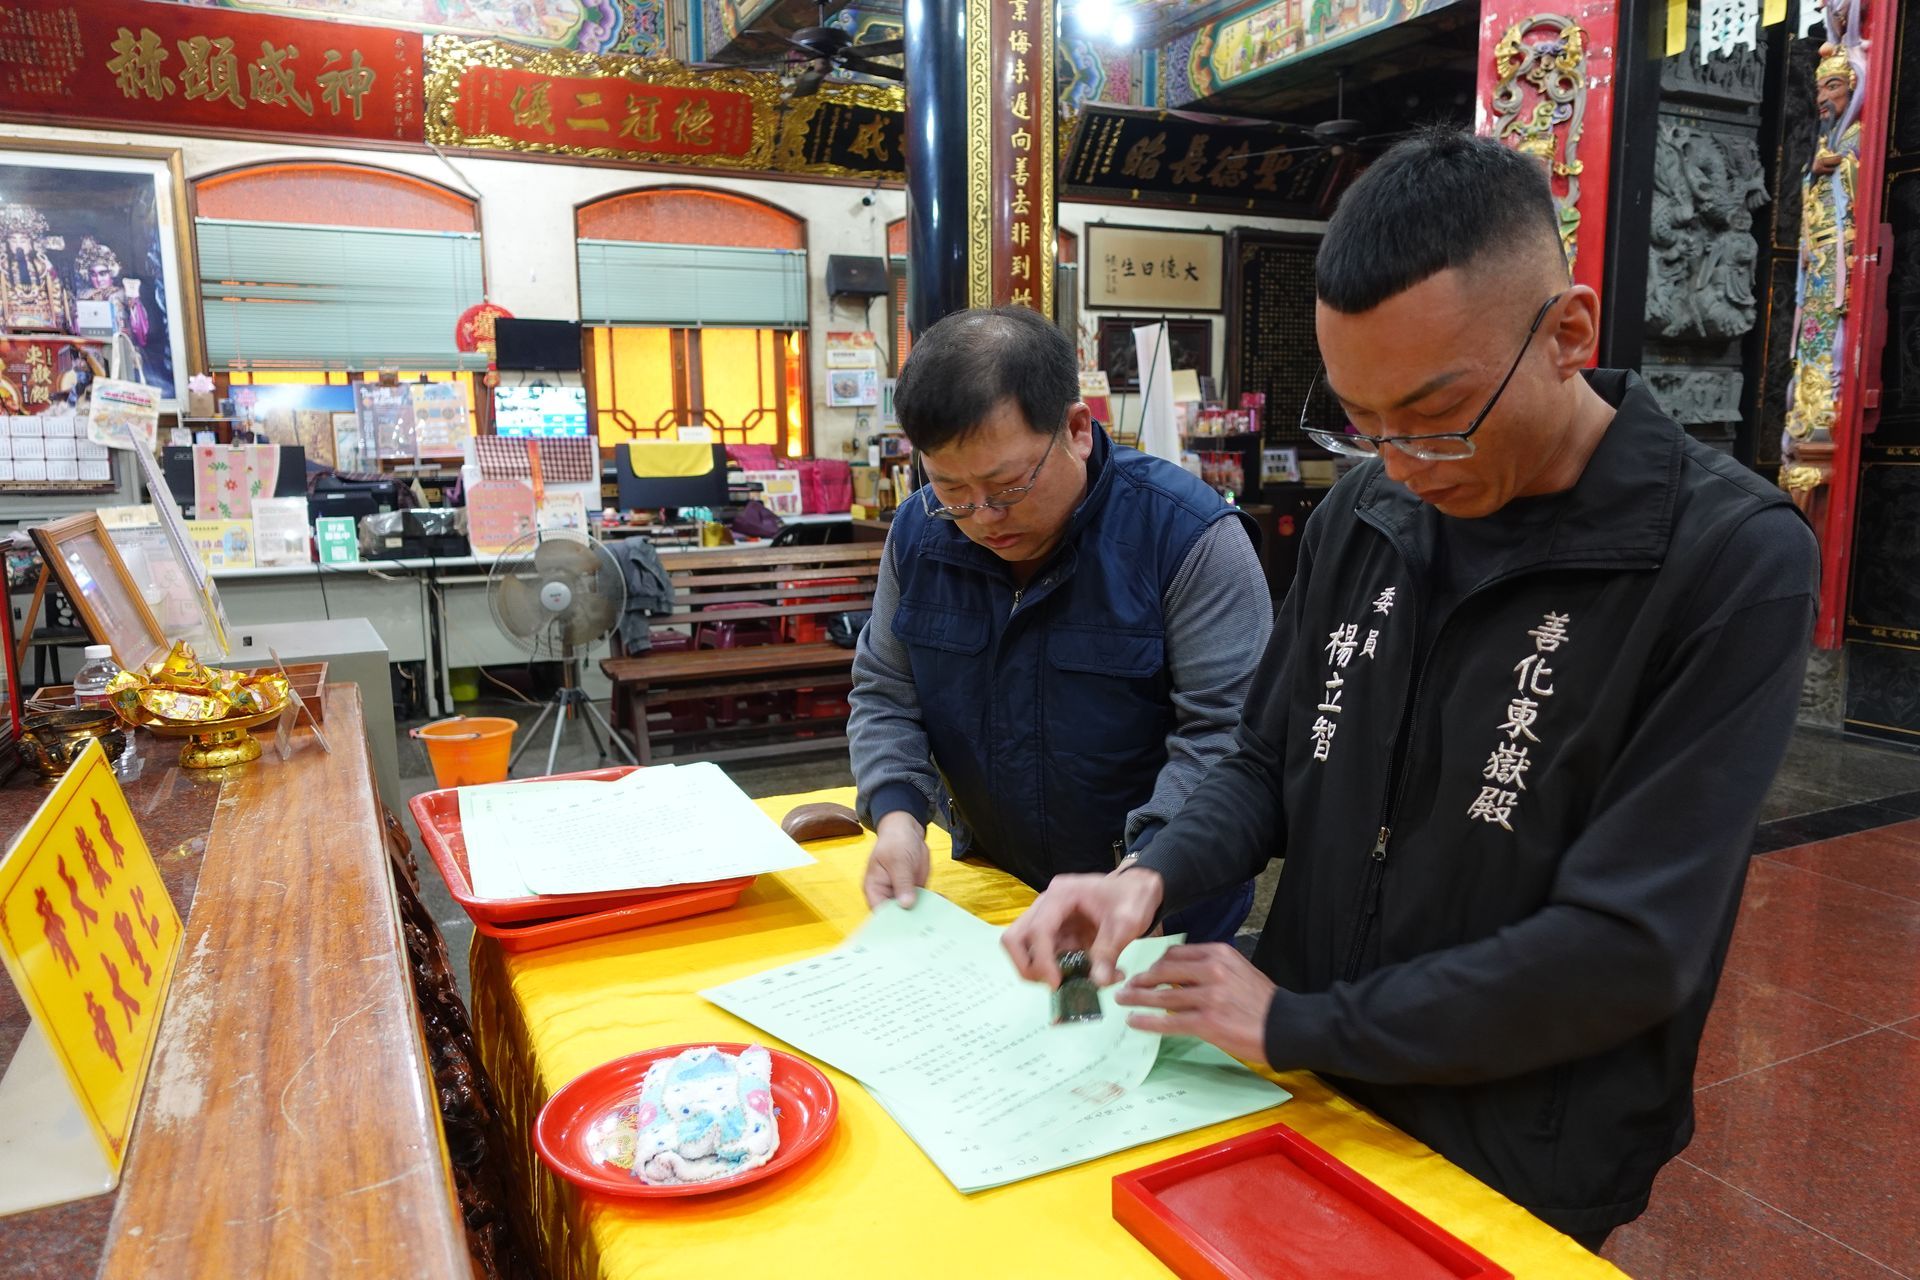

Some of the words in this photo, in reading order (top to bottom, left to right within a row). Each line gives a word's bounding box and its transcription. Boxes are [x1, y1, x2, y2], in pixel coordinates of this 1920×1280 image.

[1310, 622, 1359, 762] 楊立智
[1359, 586, 1396, 660] 委員
[1467, 610, 1571, 832] 善化東嶽殿
